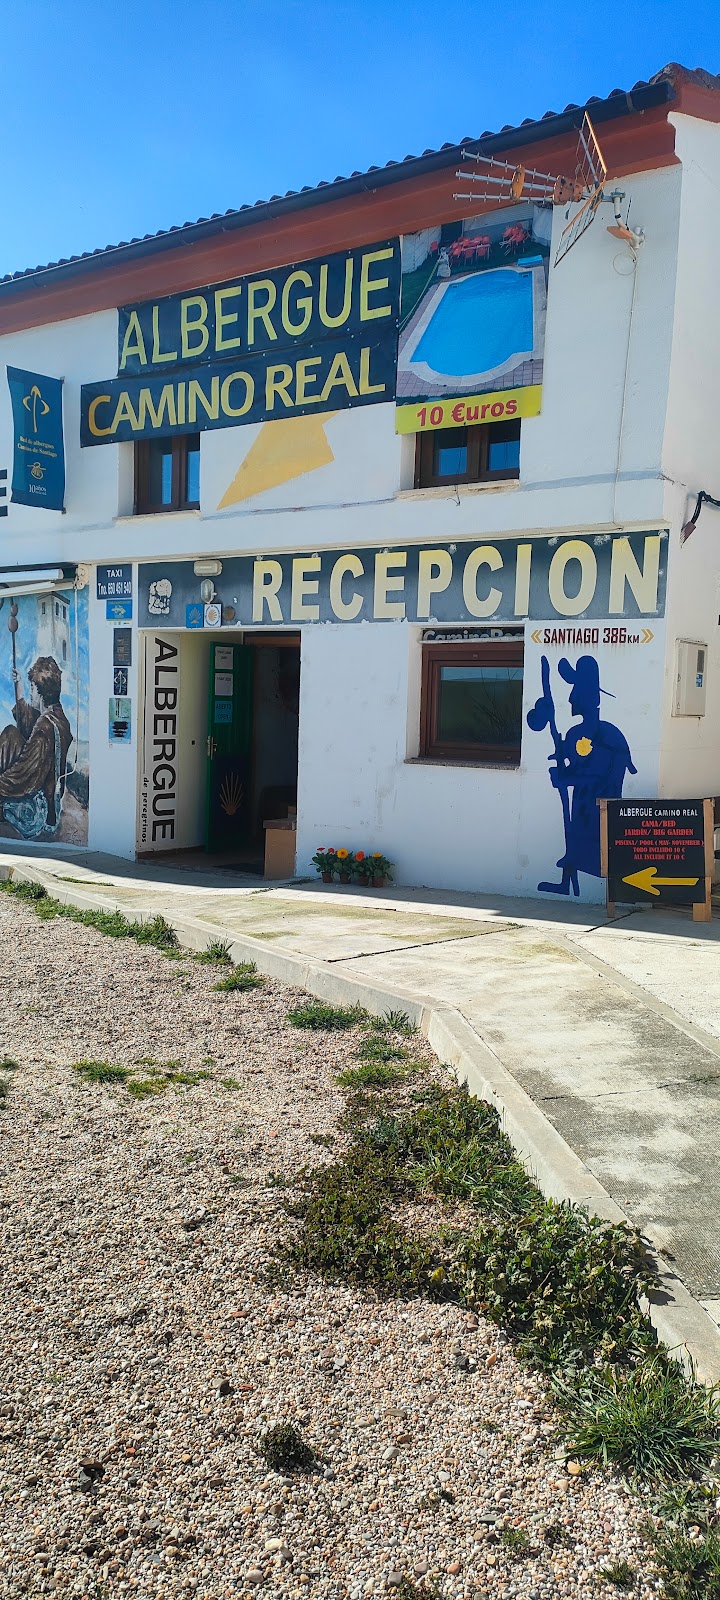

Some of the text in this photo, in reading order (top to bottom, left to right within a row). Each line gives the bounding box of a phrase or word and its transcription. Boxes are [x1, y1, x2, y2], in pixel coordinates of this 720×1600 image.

[119, 247, 394, 370] ALBERGUE
[88, 346, 386, 436] CAMINO REAL
[417, 399, 518, 427] 10 €uros
[29, 484, 36, 494] 10
[107, 569, 123, 578] TAXI
[252, 536, 661, 622] RECEPCION
[98, 582, 107, 595] Tno.
[543, 628, 600, 644] SANTIAGO
[152, 637, 179, 842] ALBERGUE
[143, 777, 148, 788] de
[619, 807, 698, 817] ALBERGUE CAMINO REAL
[641, 820, 676, 828] CAMA/BED
[667, 828, 694, 836] GARDEN
